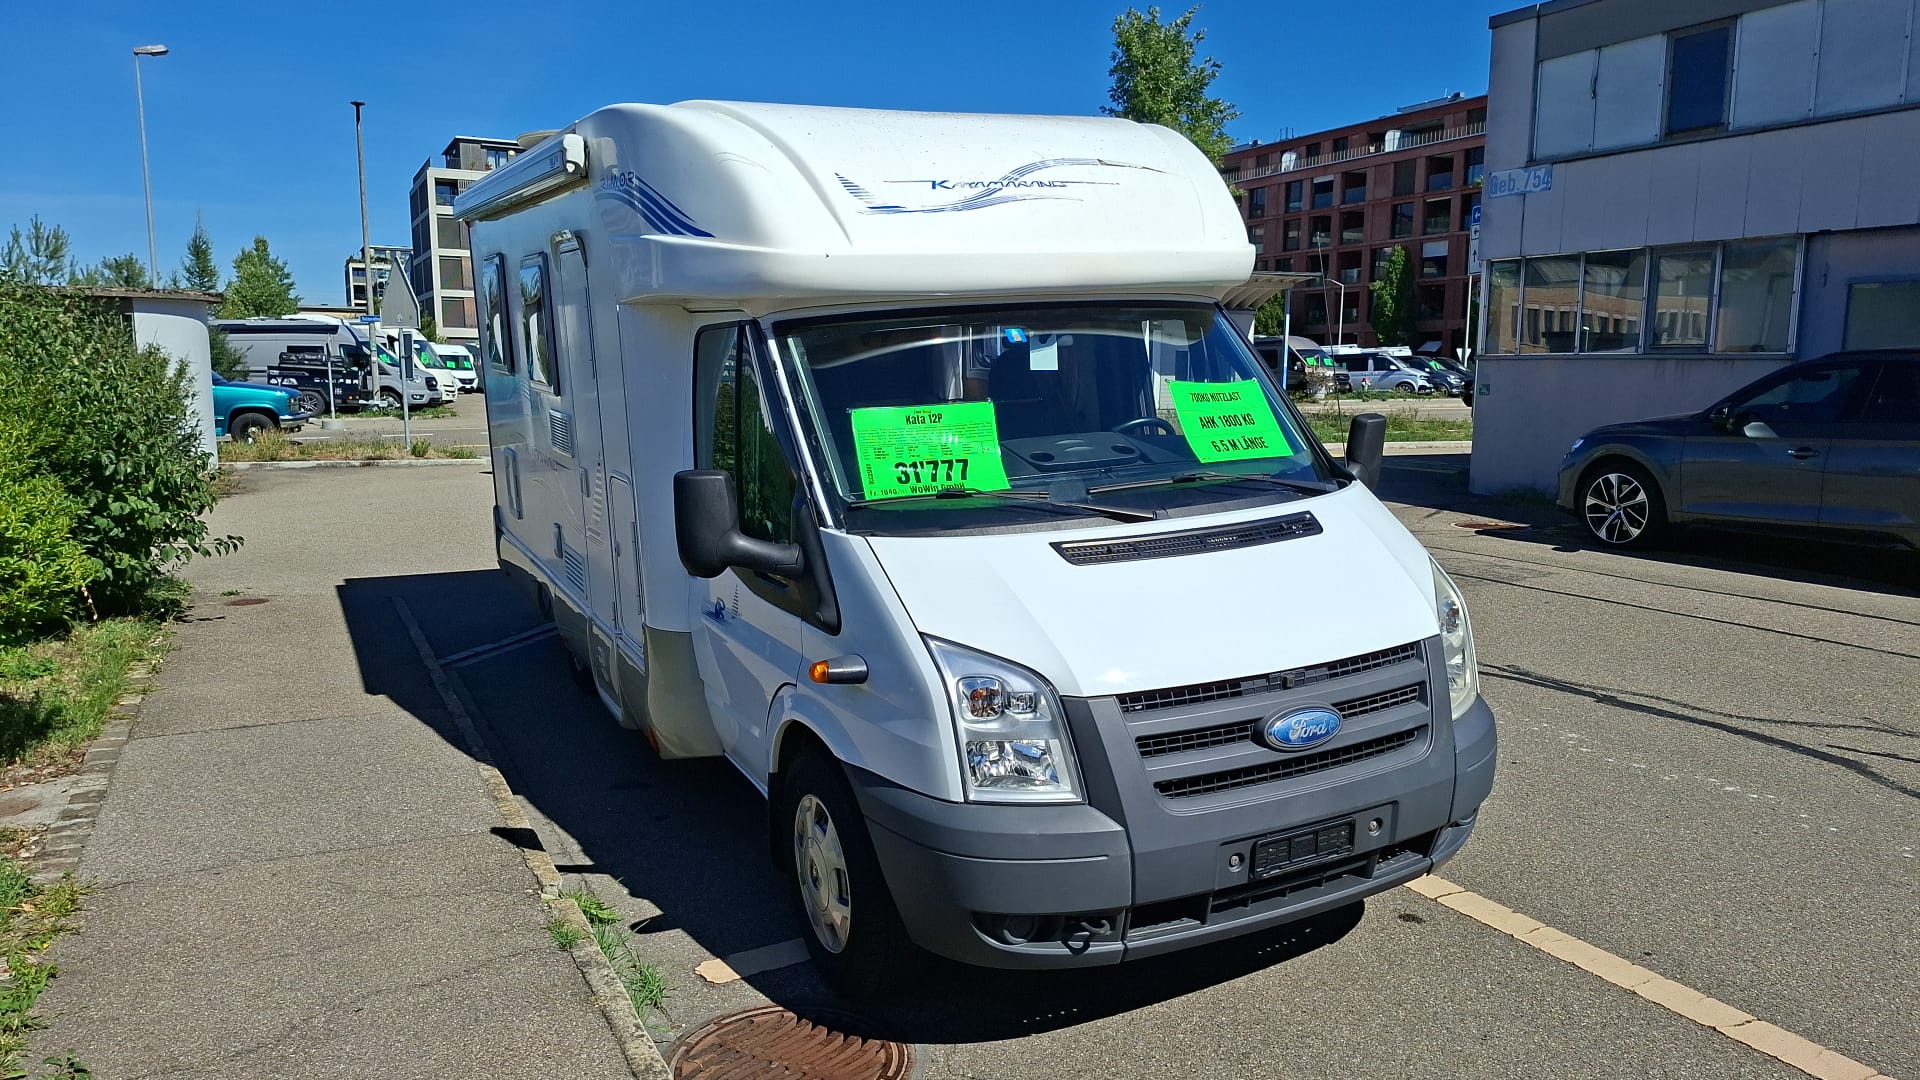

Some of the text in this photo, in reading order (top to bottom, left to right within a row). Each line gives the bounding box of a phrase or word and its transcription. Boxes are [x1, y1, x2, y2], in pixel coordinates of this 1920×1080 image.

[1489, 167, 1552, 195] Geb. 754
[928, 413, 943, 424] 12P
[1199, 413, 1255, 429] AHK 1800 KG
[1211, 435, 1269, 453] 6.5 M LÄNGE
[894, 458, 969, 485] 31'777
[1289, 719, 1328, 739] Ford
